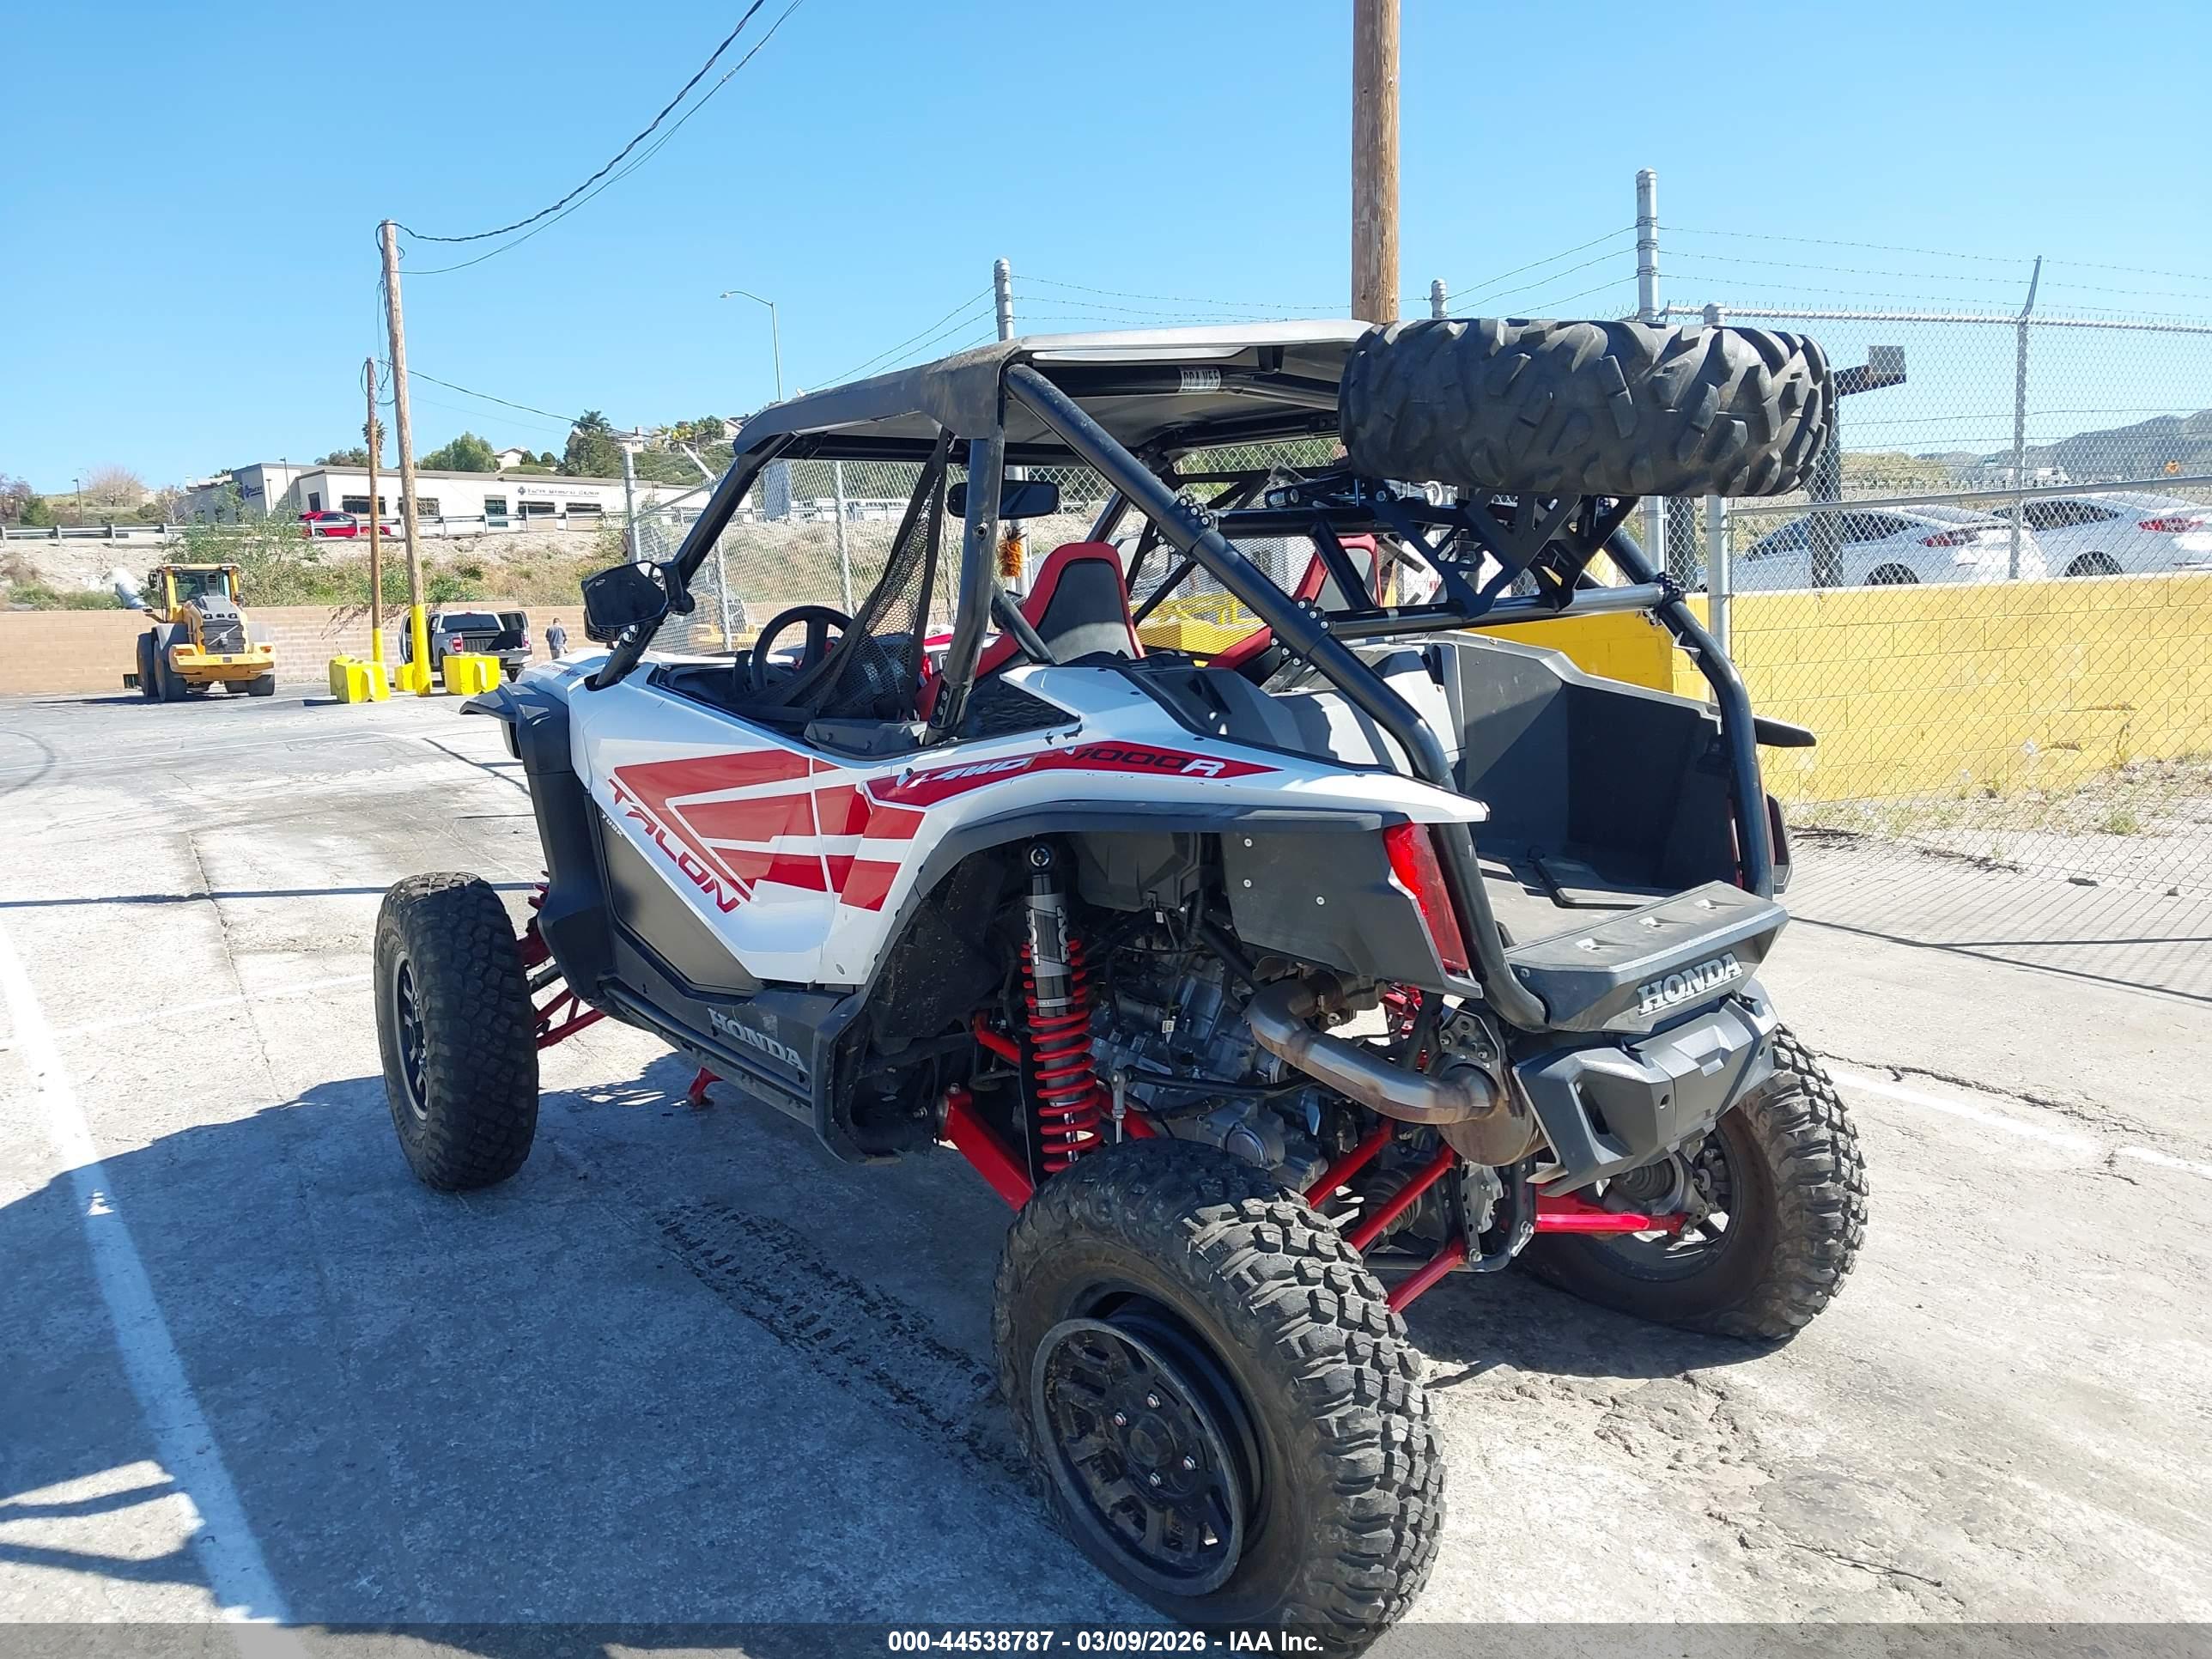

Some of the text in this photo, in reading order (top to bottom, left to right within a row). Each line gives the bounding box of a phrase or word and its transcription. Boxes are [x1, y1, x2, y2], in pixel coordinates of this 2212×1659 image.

[1073, 748, 1226, 777] 1000R
[600, 811, 625, 839] TUSK
[608, 778, 741, 915] TALON
[1637, 951, 1744, 1018] HONDA
[707, 1006, 810, 1076] HONDA
